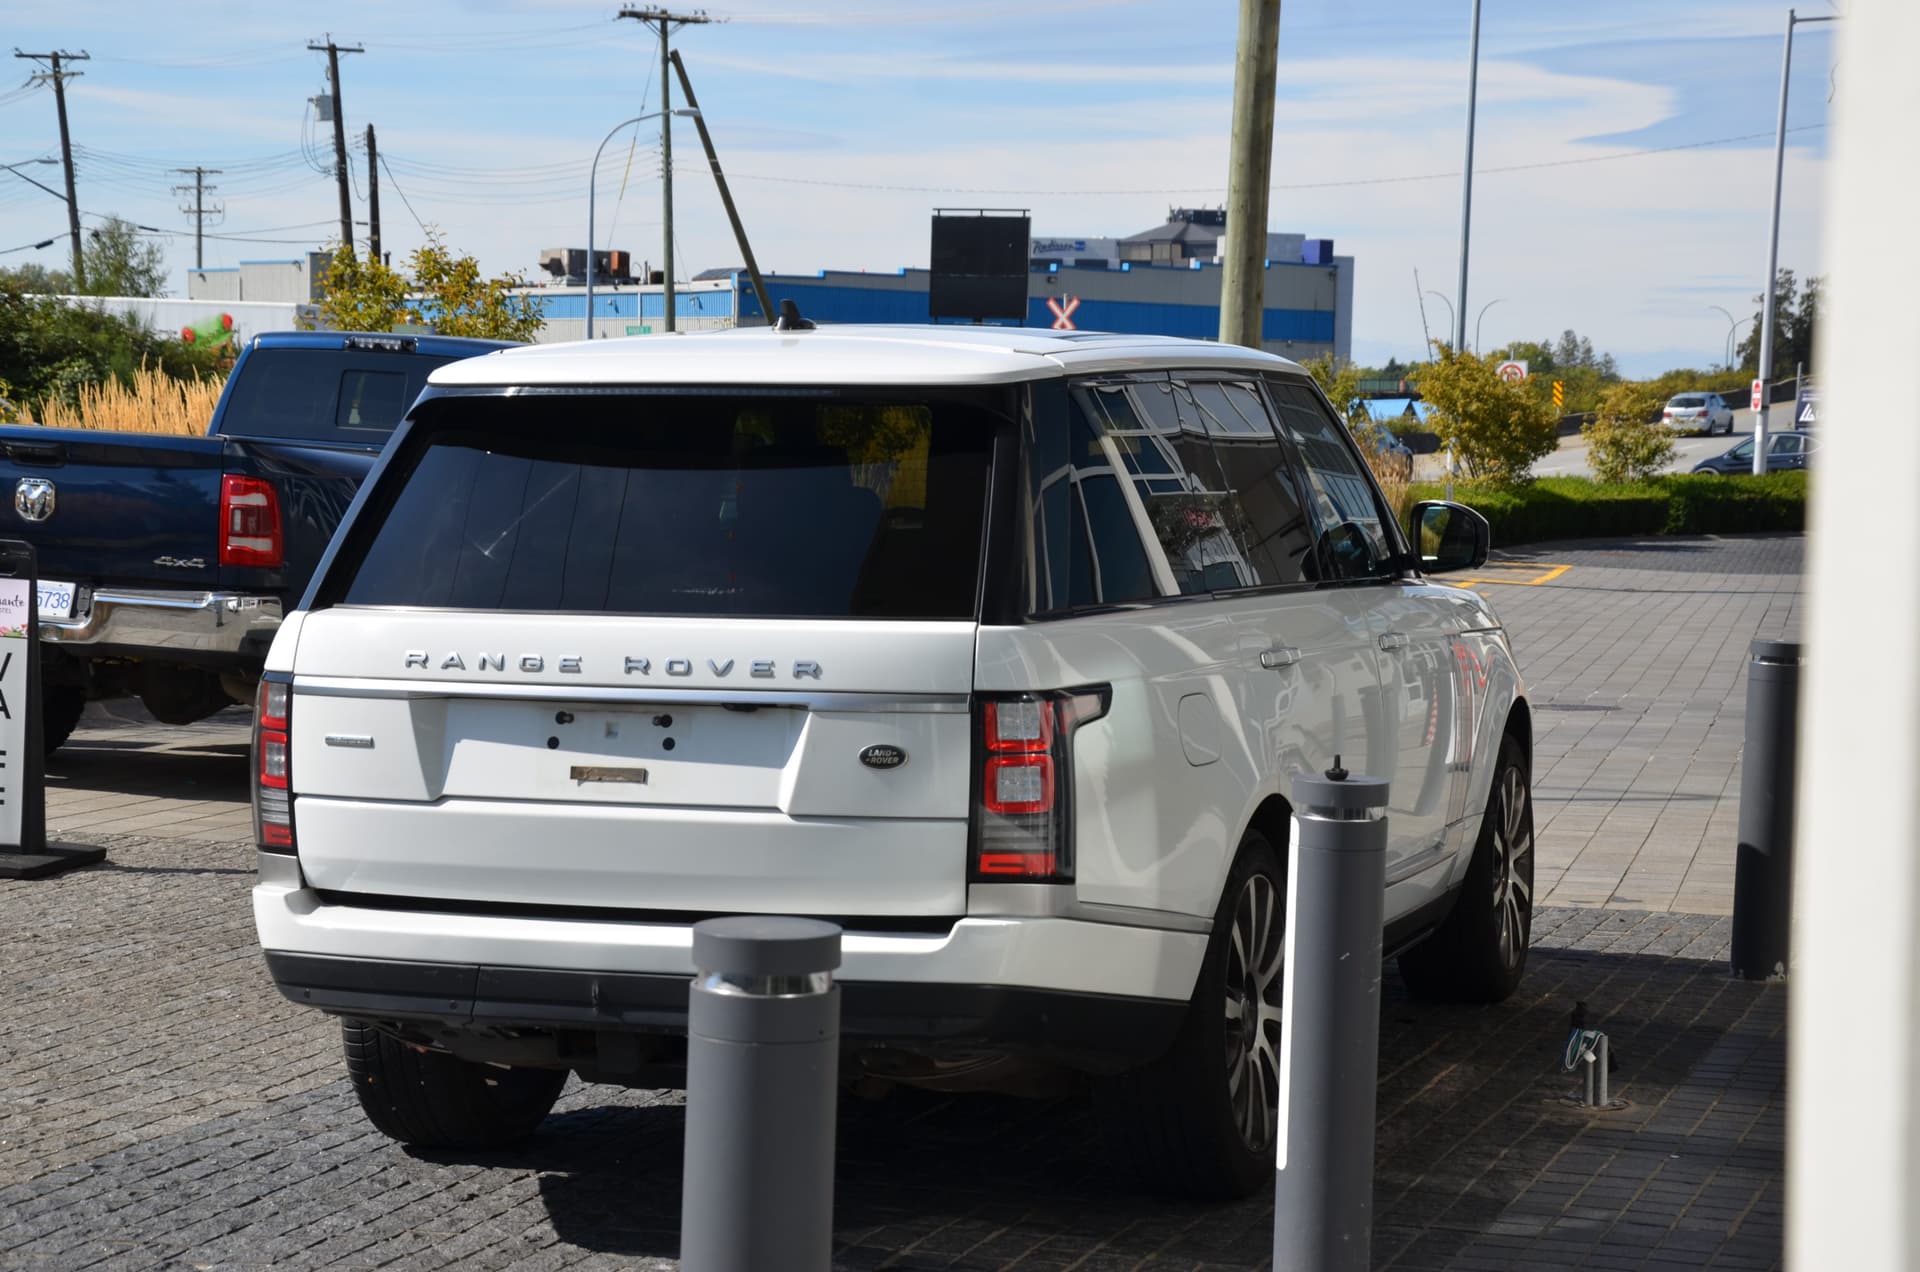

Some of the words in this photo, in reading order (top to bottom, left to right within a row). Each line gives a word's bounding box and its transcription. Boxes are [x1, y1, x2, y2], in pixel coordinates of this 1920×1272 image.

[153, 556, 206, 568] 4x4
[405, 650, 583, 674] RANGE
[624, 656, 824, 680] ROVER
